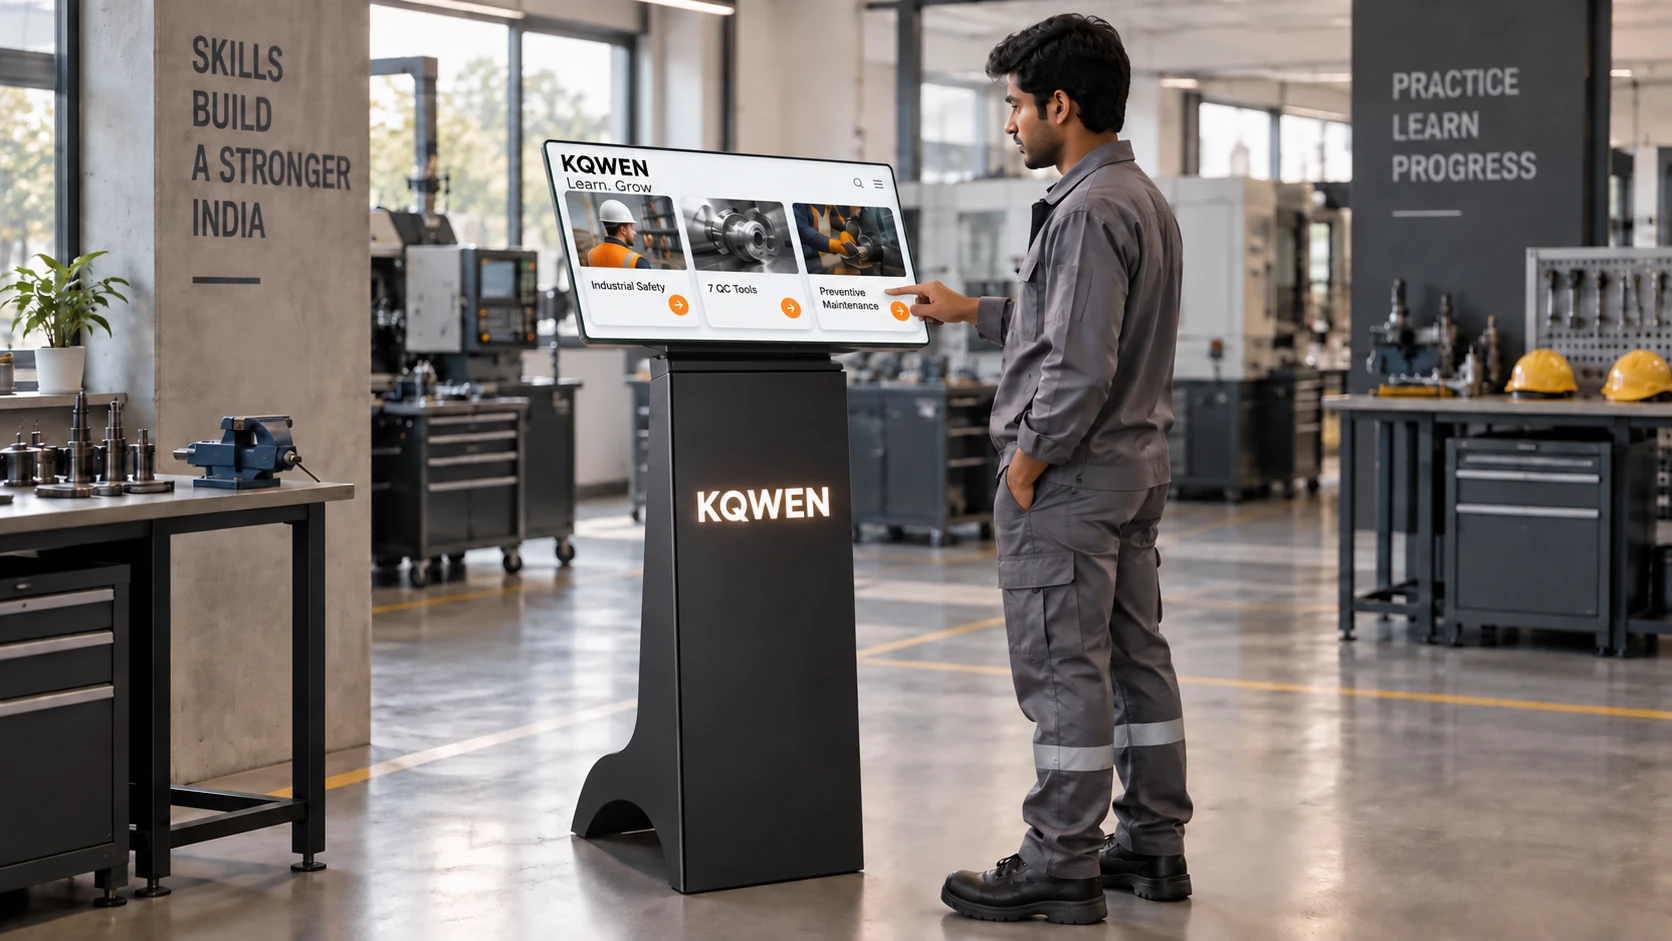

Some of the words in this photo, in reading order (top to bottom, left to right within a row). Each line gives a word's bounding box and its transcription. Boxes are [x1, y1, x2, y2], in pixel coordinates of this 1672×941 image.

[192, 35, 283, 83] SKILLS
[1392, 67, 1520, 100] PRACTICE
[192, 89, 272, 132] BUILD
[1392, 110, 1479, 142] LEARN
[191, 143, 211, 182] A
[219, 146, 351, 190] STRONGER
[560, 154, 650, 178] KQWEN
[1391, 151, 1537, 183] PROGRESS
[566, 177, 612, 192] Learn.
[615, 180, 652, 194] Grow
[192, 198, 266, 238] INDIA
[591, 280, 635, 292] Industrial
[636, 281, 666, 294] Safety
[707, 283, 714, 294] 7
[716, 284, 732, 295] QC
[733, 284, 758, 295] Tools
[819, 287, 867, 298] Preventive
[822, 300, 880, 312] Maintenance
[697, 486, 830, 523] KQWEN
